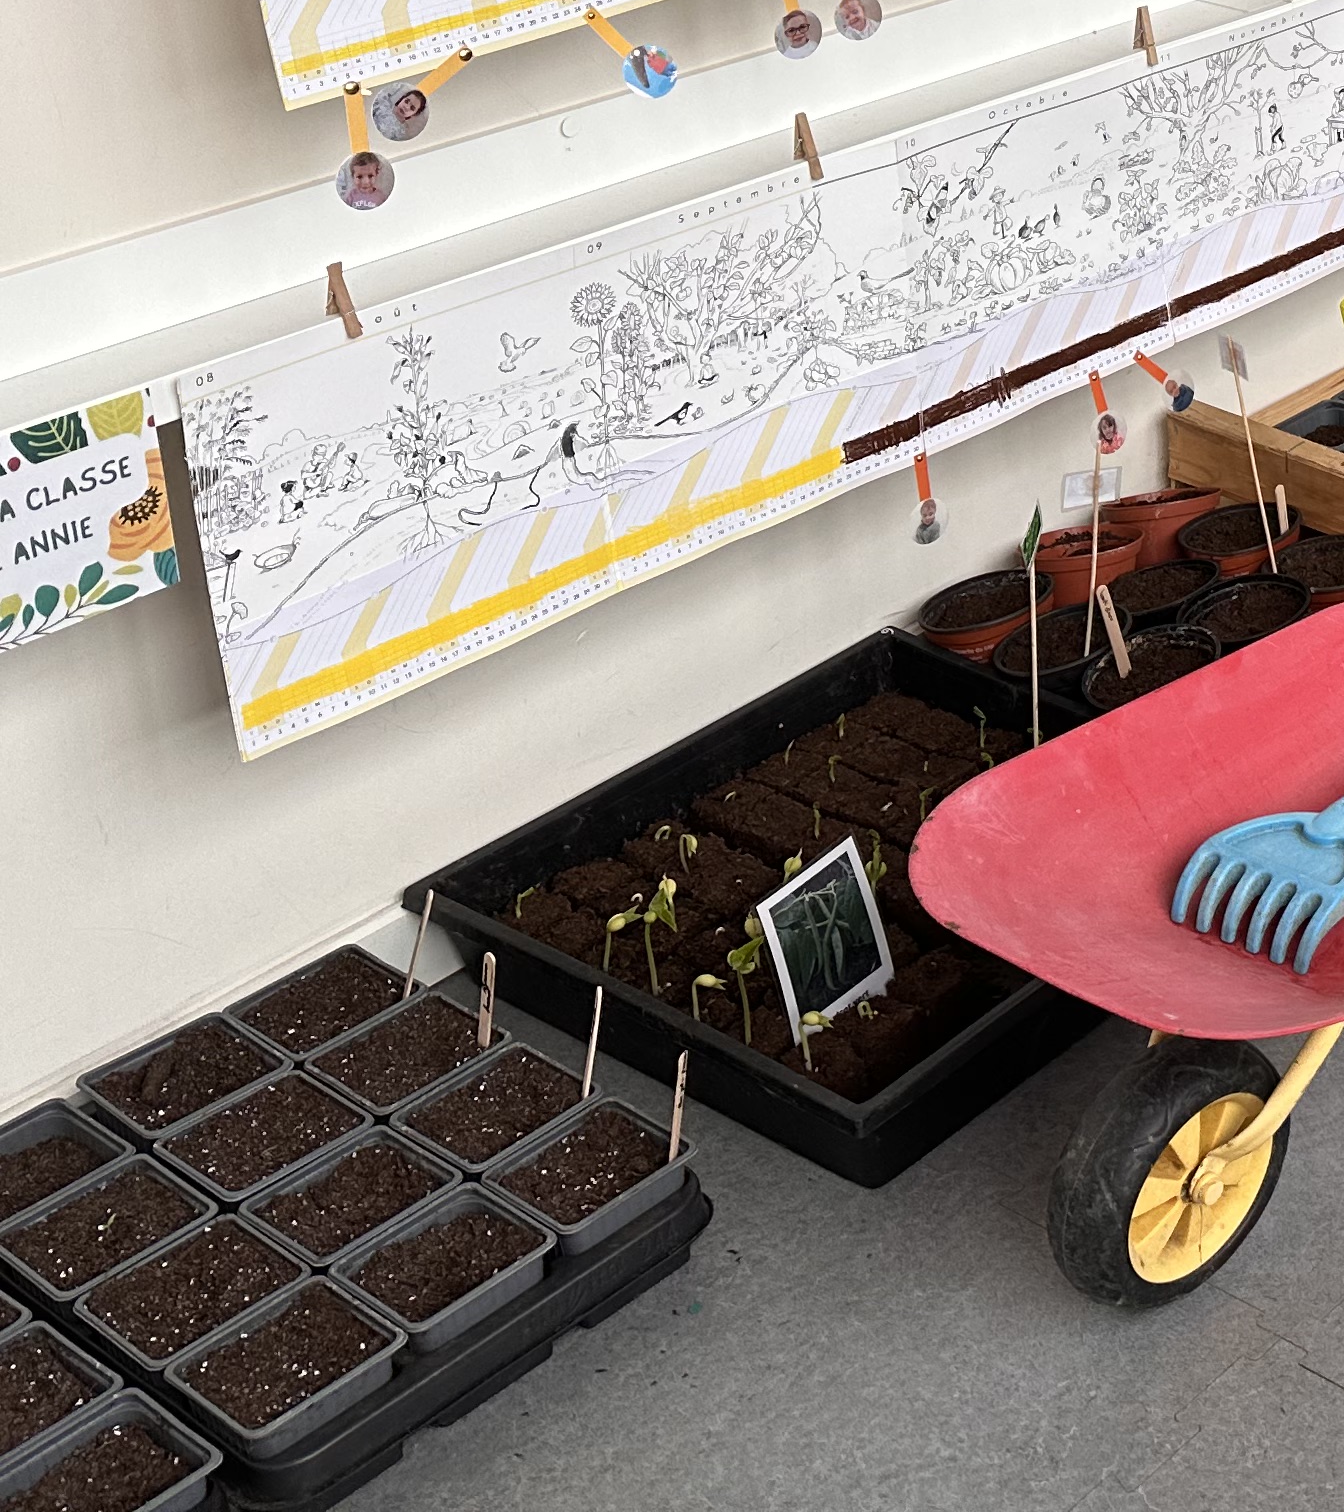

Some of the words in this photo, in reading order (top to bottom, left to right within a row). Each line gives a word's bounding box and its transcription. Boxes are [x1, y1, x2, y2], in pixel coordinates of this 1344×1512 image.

[1228, 11, 1305, 42] Novembre
[904, 138, 916, 149] 10
[989, 90, 1068, 120] Octobre
[587, 241, 602, 254] 09
[678, 175, 801, 224] Septembre
[195, 372, 215, 387] 08
[374, 302, 419, 325] oût
[26, 455, 132, 511] CLASSE
[14, 516, 94, 565] ANNIE
